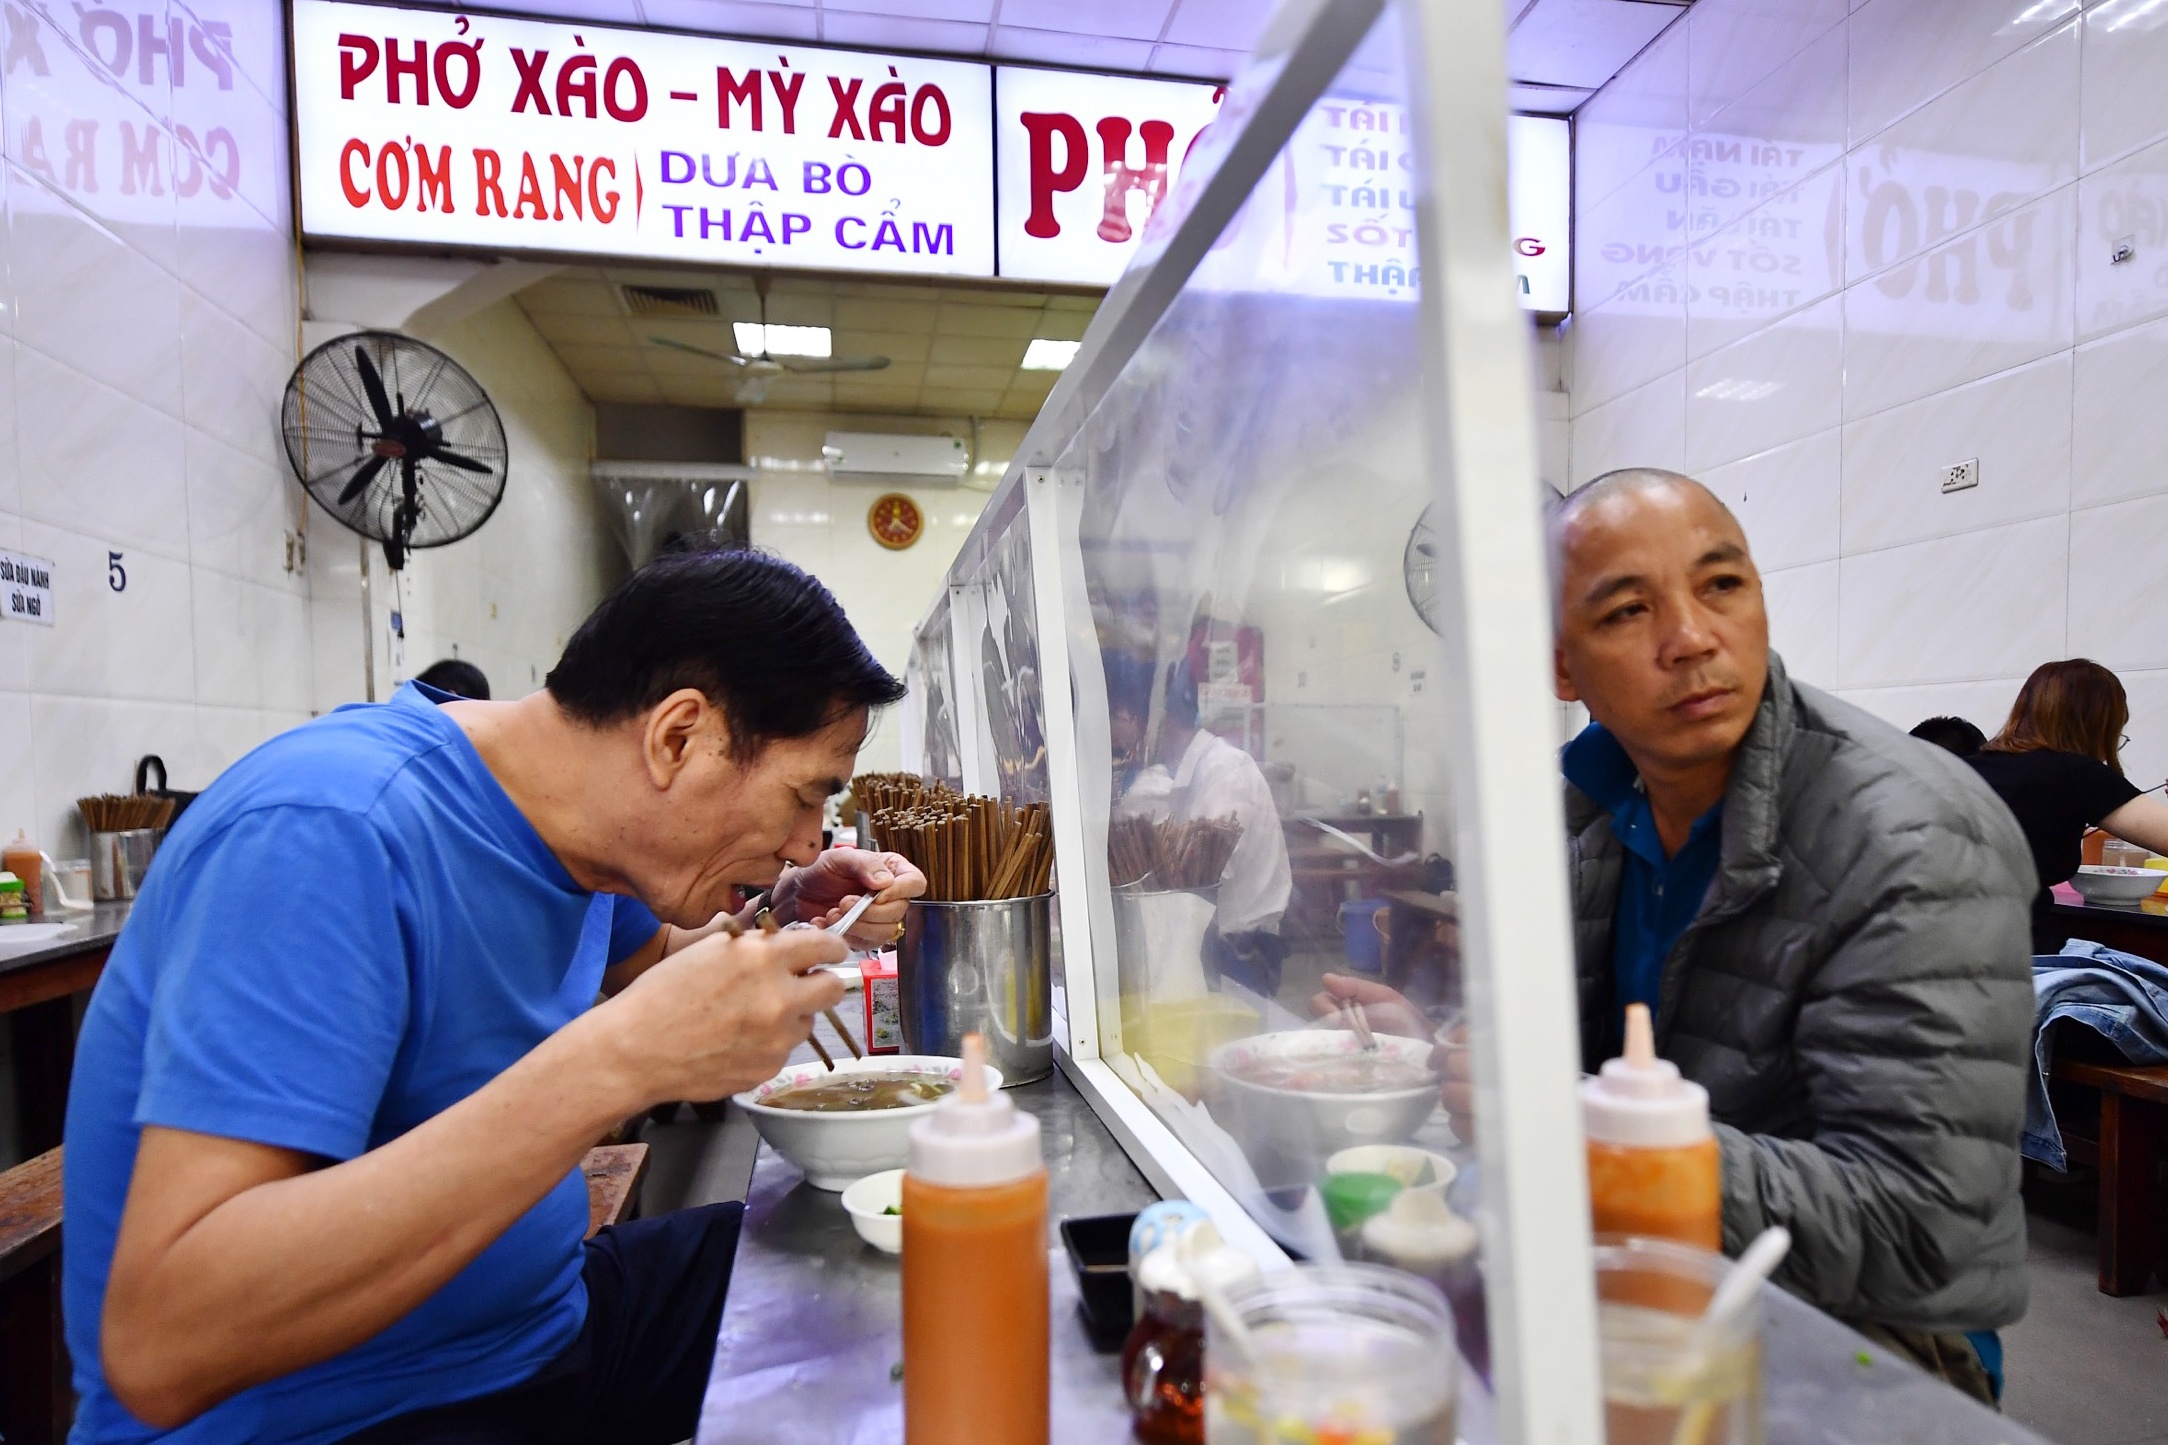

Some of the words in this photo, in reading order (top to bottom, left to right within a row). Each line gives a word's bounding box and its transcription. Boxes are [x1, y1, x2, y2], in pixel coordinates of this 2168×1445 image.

[338, 15, 484, 109] PHỞ
[510, 35, 648, 122] XÀO
[717, 56, 805, 134] MỲ
[828, 66, 951, 146] XÀO
[661, 150, 778, 191] DƯA
[804, 154, 872, 196] BÒ
[1319, 138, 1389, 171] TÁI
[340, 136, 454, 213] CƠM
[473, 149, 622, 224] RANG
[1320, 177, 1389, 209] TÁI
[662, 200, 811, 254] THẬP
[834, 199, 954, 255] CẨM
[108, 549, 127, 592] 5
